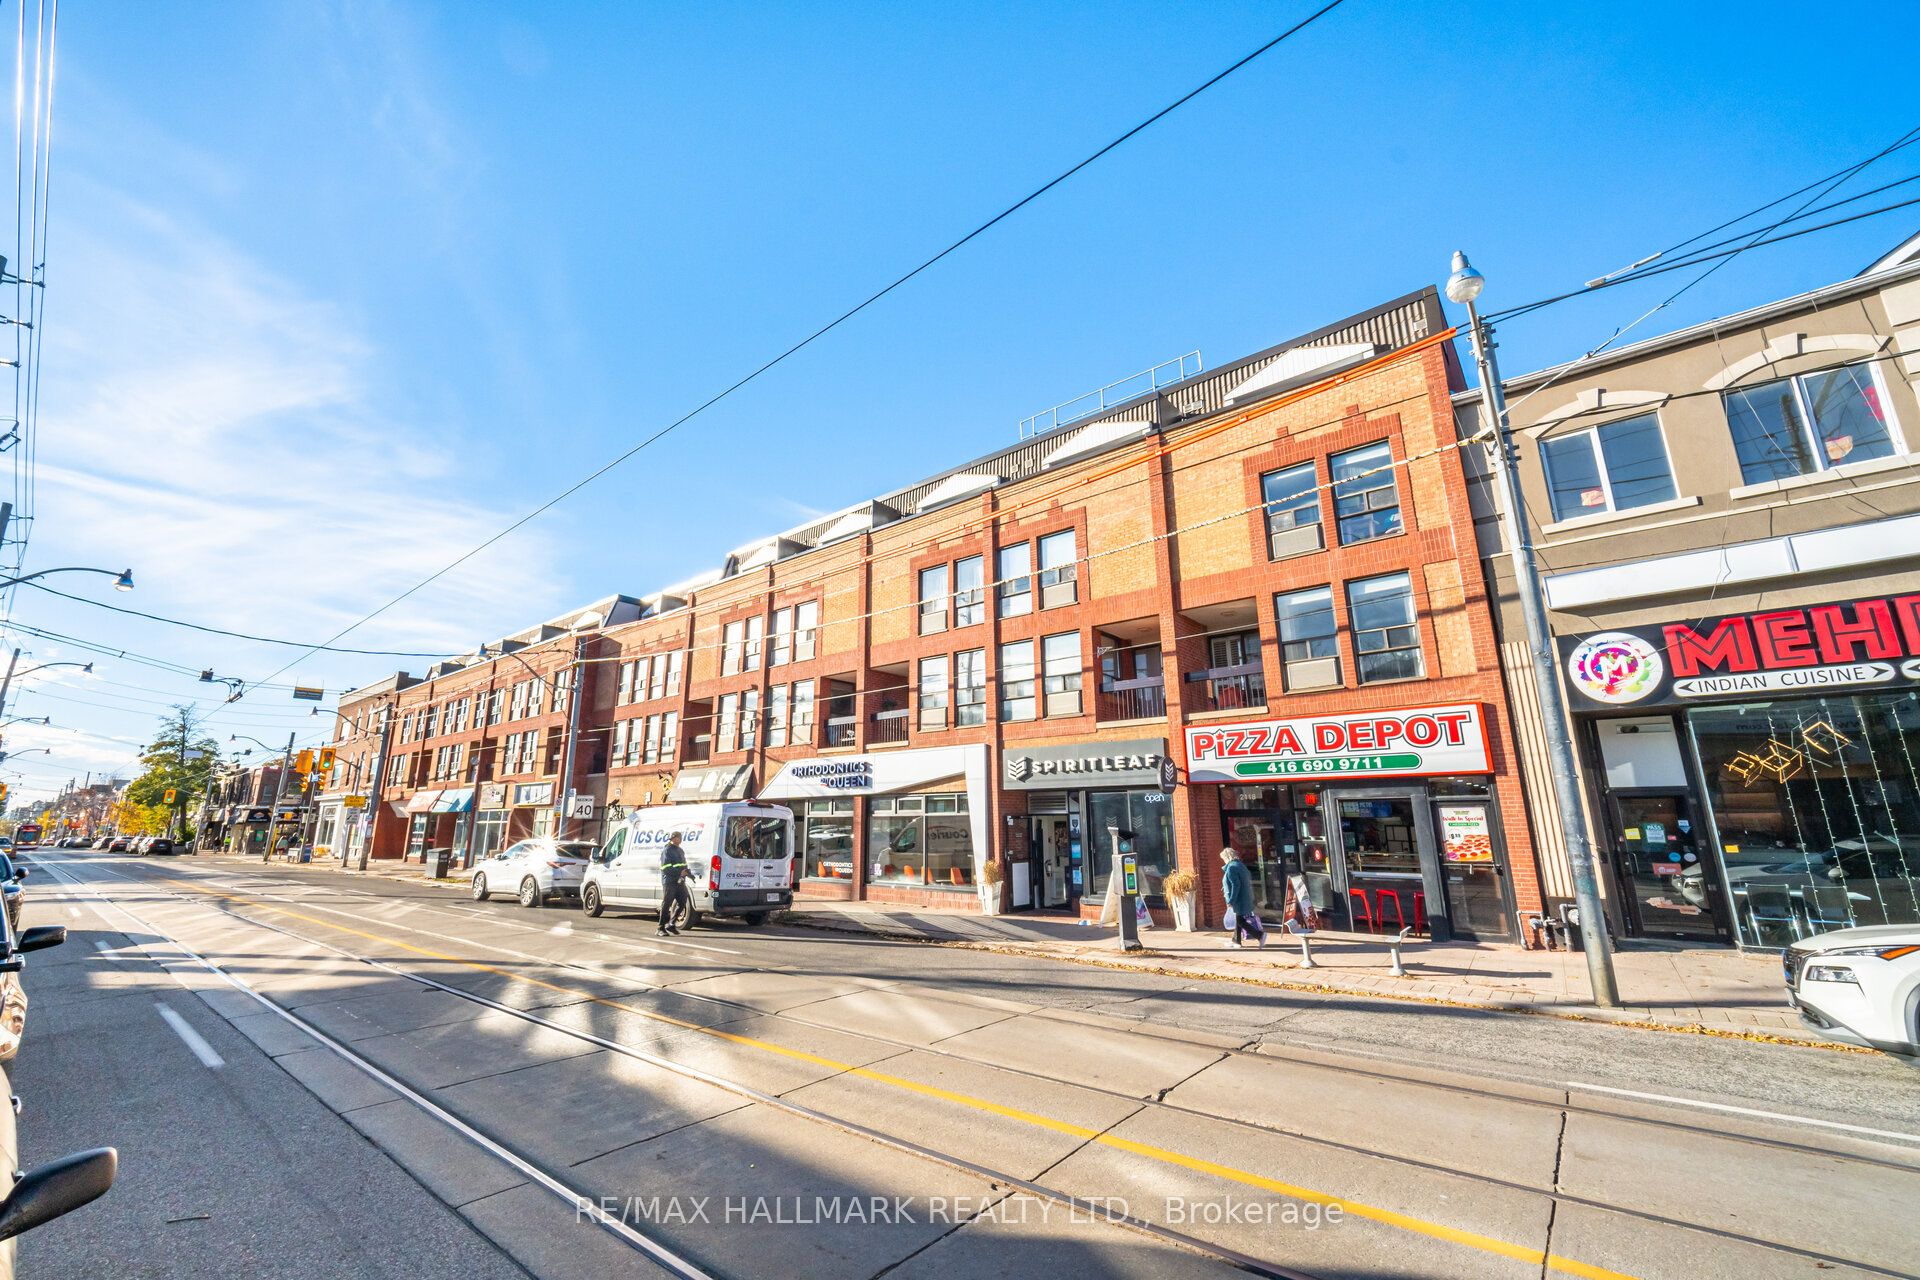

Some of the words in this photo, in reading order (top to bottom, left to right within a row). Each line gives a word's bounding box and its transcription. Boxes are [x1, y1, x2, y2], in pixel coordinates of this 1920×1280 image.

[1698, 676, 1767, 693] INDIAN
[1781, 667, 1865, 686] CUISINE
[1314, 713, 1468, 752] DEPOT
[791, 762, 867, 777] ORTHODONTICS
[1031, 753, 1156, 774] SPIRITLEAF
[1267, 761, 1297, 772] 416
[1302, 759, 1333, 771] 690
[1339, 757, 1382, 770] 9711
[828, 774, 867, 789] QUEEN
[576, 804, 592, 816] 40
[634, 829, 654, 844] ICS
[655, 827, 703, 843] Coier
